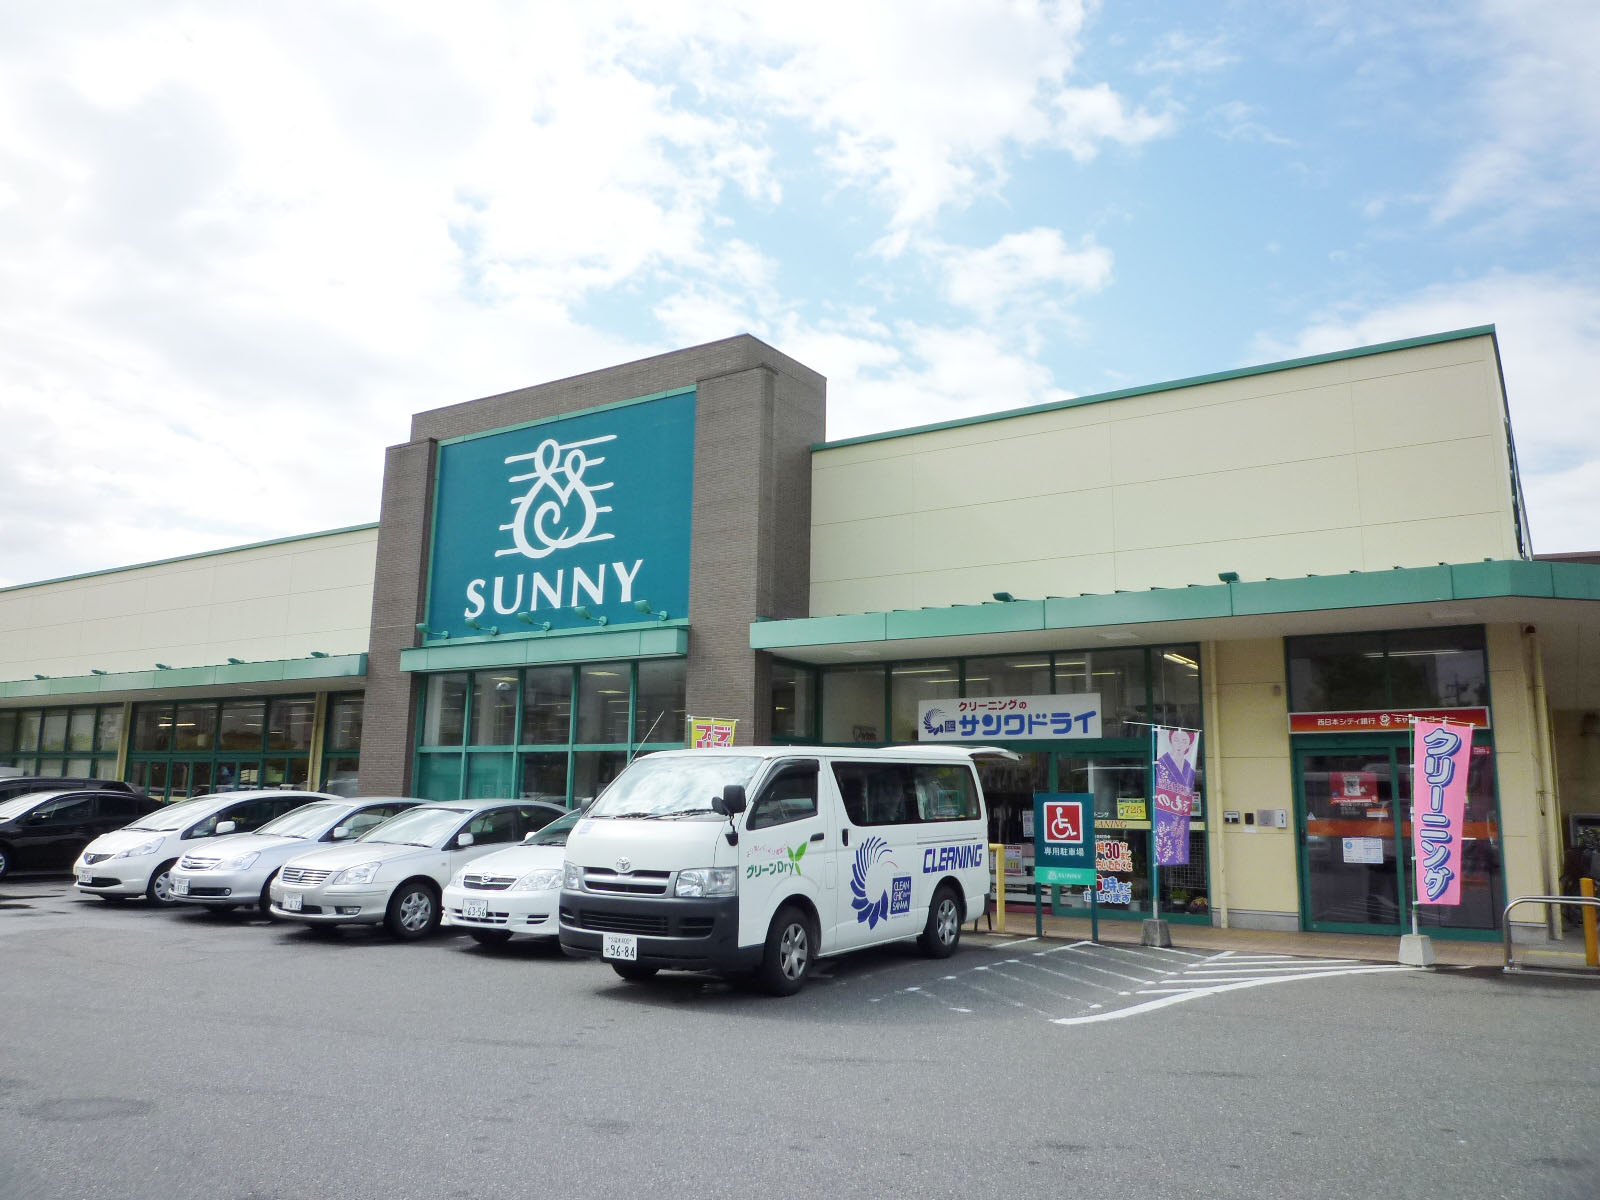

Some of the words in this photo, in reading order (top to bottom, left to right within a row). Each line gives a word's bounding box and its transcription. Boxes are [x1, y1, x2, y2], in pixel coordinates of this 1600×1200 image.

[464, 559, 644, 618] SUNNY
[958, 699, 1027, 712] クリーニングの
[958, 710, 1097, 737] サンワドライ
[1317, 717, 1376, 726] 西日本シティ銀行
[1420, 728, 1461, 900] クリーニング
[1095, 820, 1128, 828] ANING
[1043, 846, 1085, 857] 専用駐車場
[922, 844, 983, 873] CLEANING
[893, 881, 910, 891] CLEAN
[467, 906, 486, 917] 63-56
[610, 944, 635, 959] 96-84
